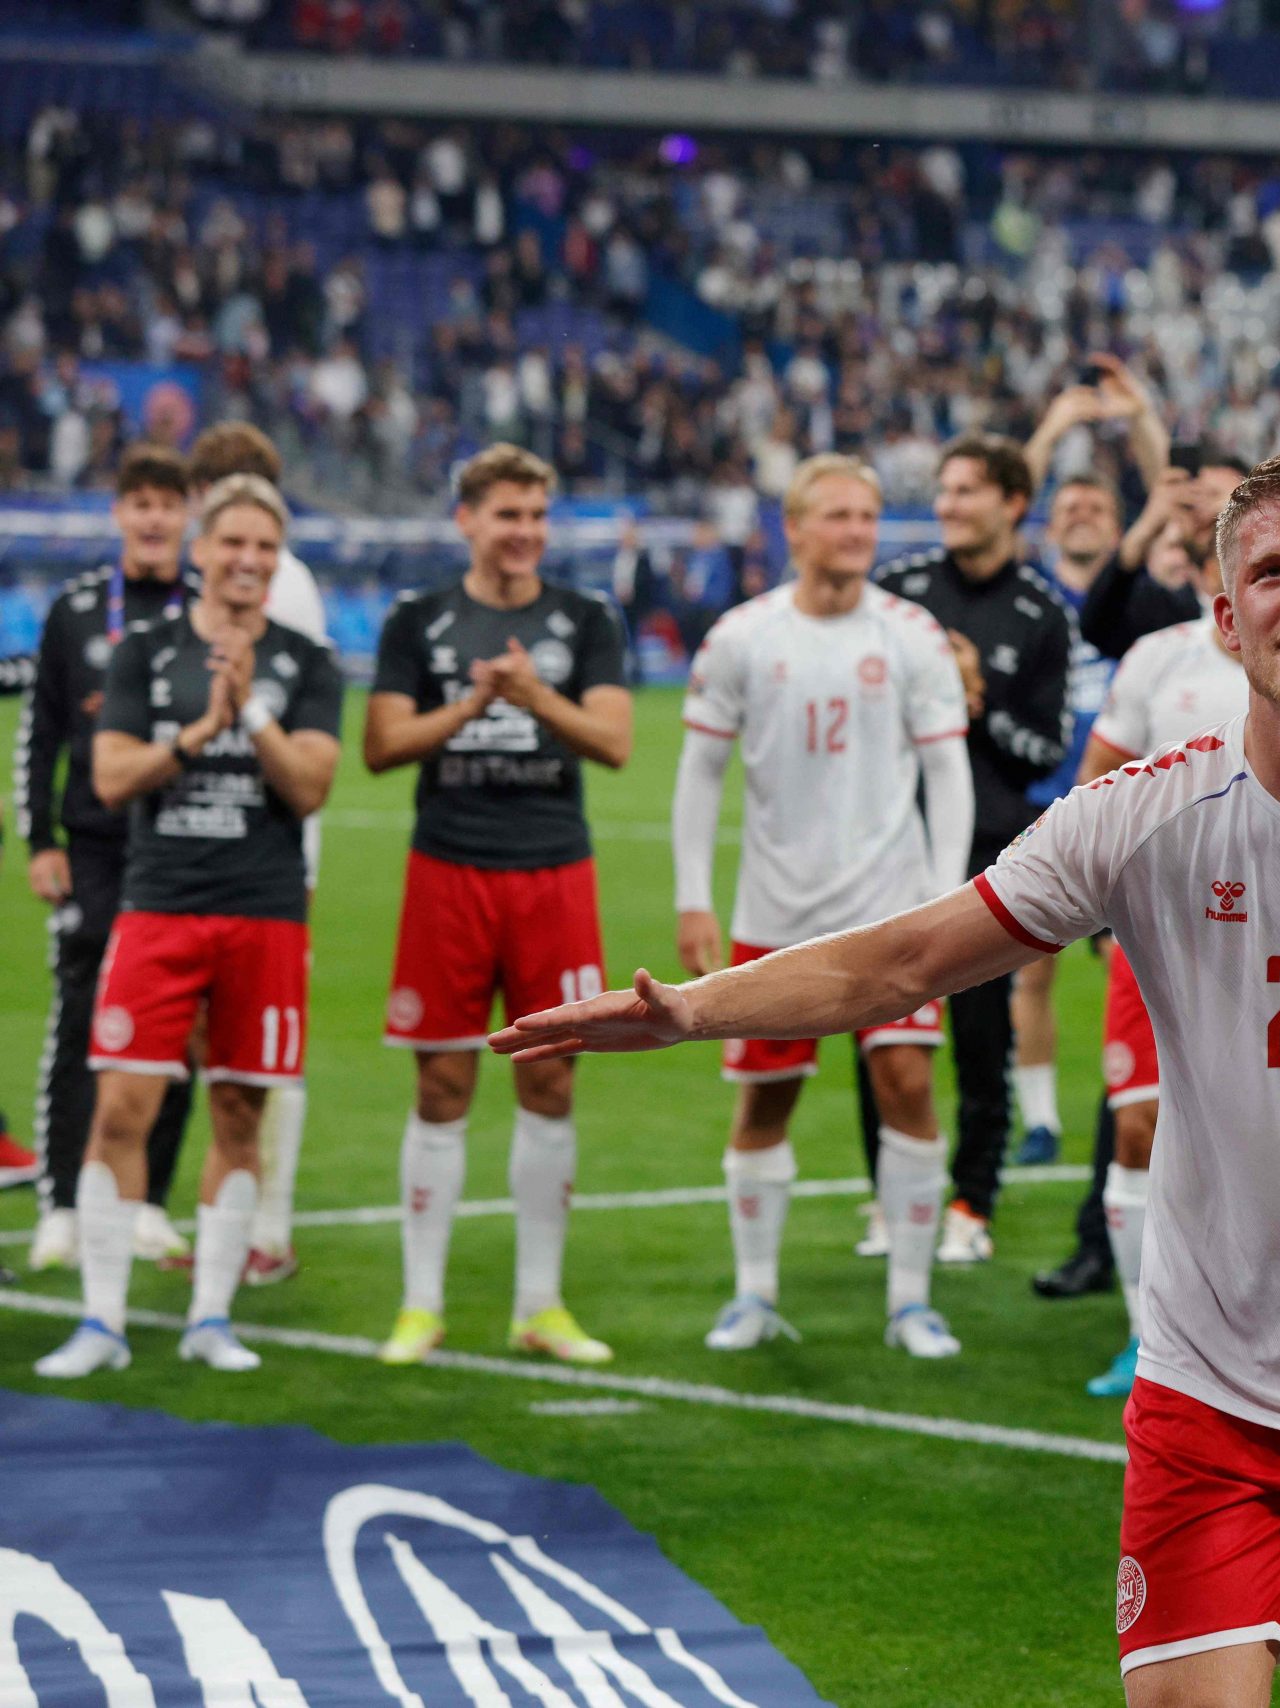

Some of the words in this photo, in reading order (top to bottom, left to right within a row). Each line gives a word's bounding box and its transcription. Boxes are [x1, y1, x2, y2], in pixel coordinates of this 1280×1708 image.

[806, 697, 849, 754] 12
[1206, 907, 1248, 923] hummel
[262, 1005, 300, 1070] 11
